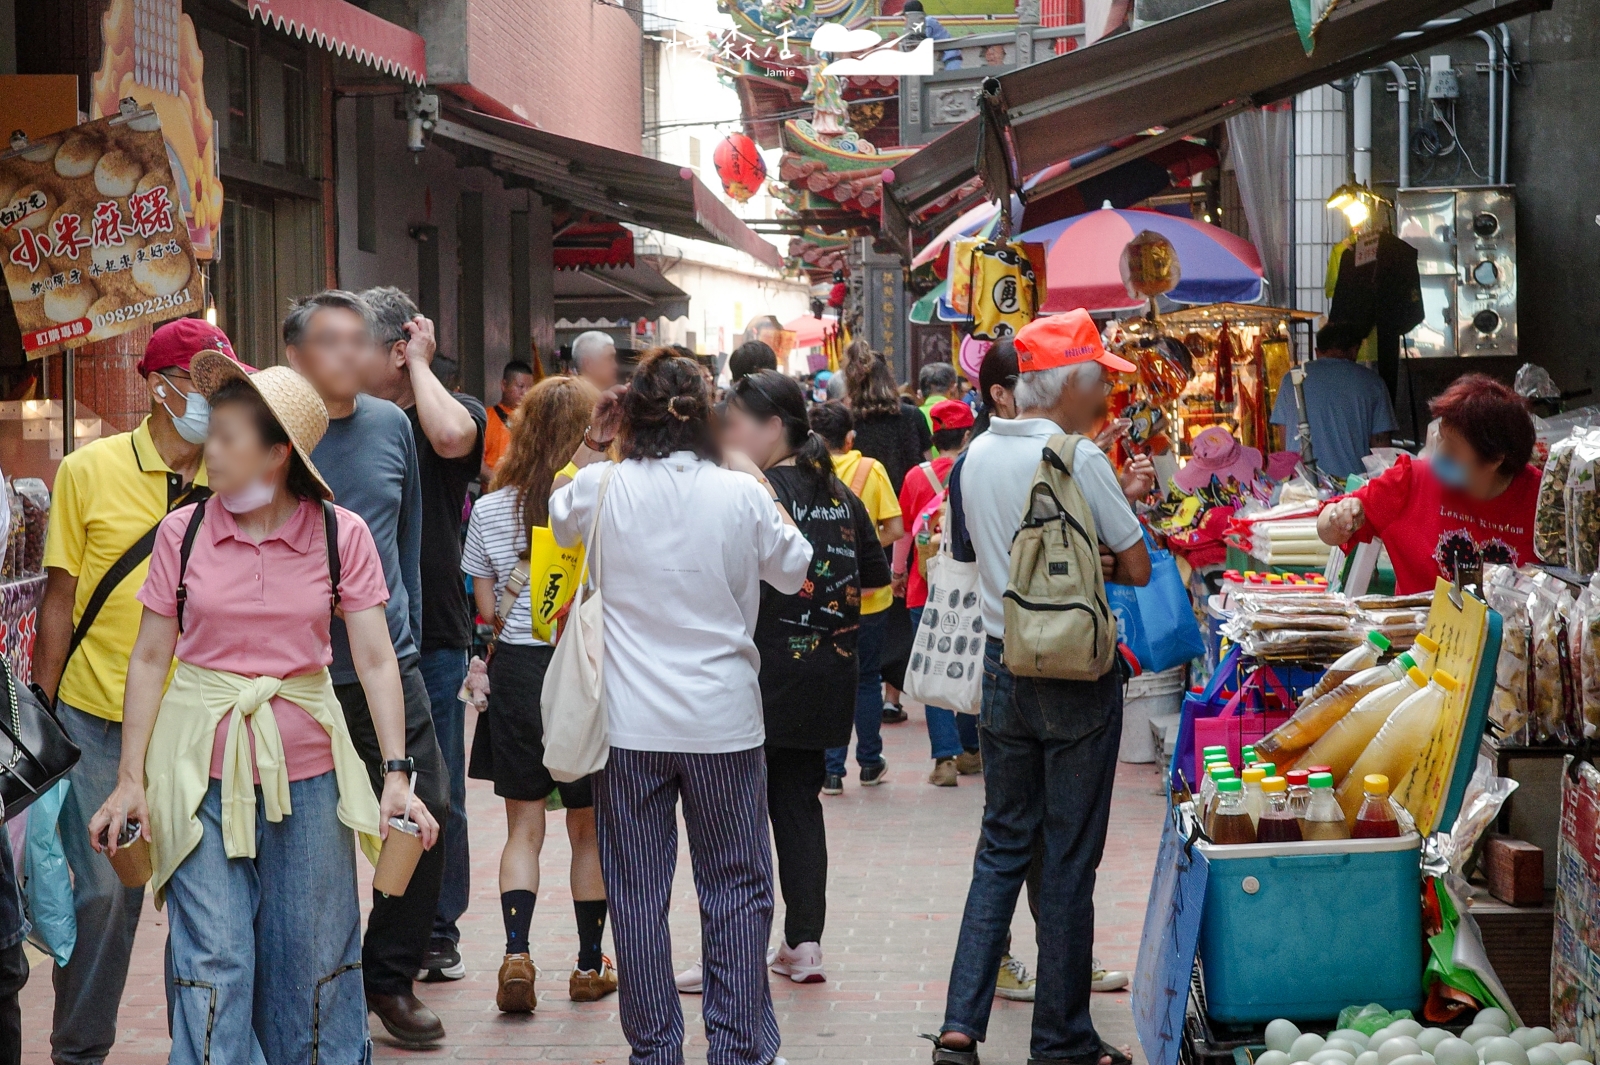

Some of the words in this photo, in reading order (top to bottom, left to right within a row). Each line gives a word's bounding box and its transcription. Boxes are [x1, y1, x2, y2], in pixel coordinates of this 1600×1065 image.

[11, 186, 173, 271] 小米麻糬
[36, 322, 85, 346] 訂購專線
[95, 288, 193, 328] 0982922361
